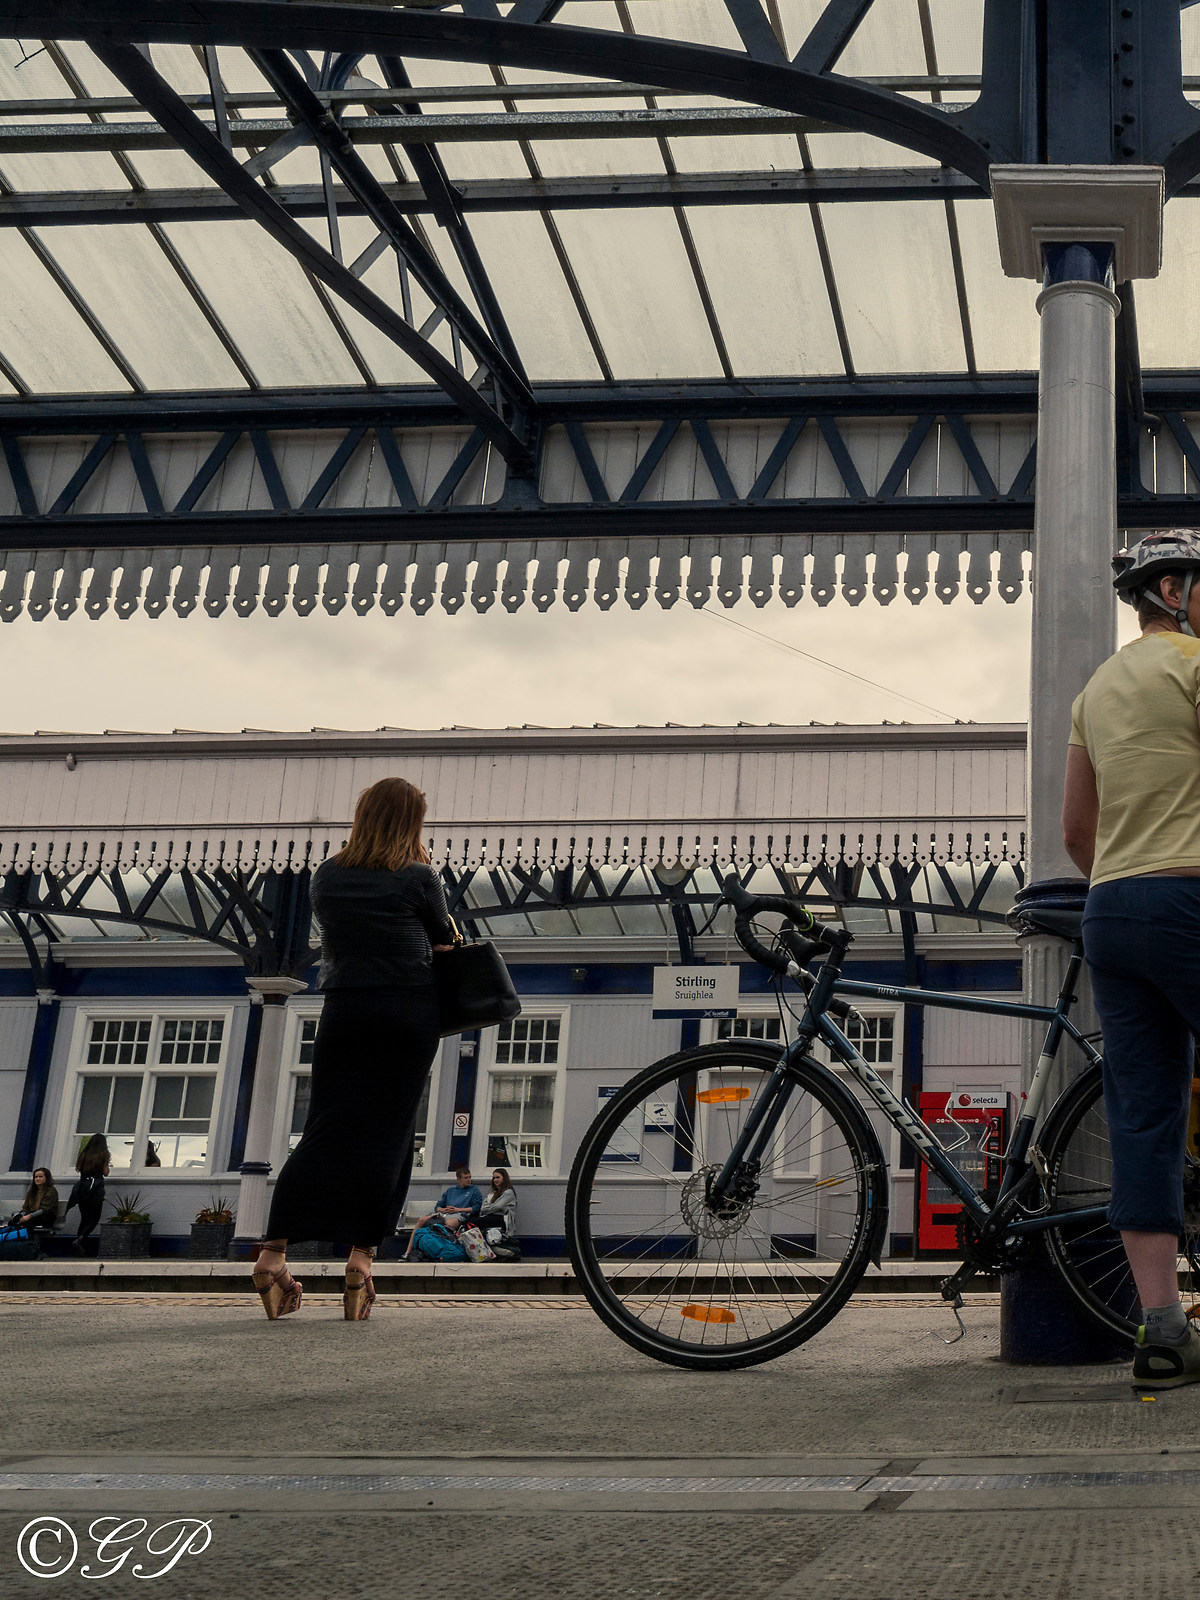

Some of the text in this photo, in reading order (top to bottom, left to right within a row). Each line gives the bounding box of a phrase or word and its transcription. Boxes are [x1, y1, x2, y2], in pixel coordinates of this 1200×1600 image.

[675, 976, 716, 989] Stirling
[674, 990, 714, 1001] Sruighlea
[877, 986, 899, 996] SUTRA
